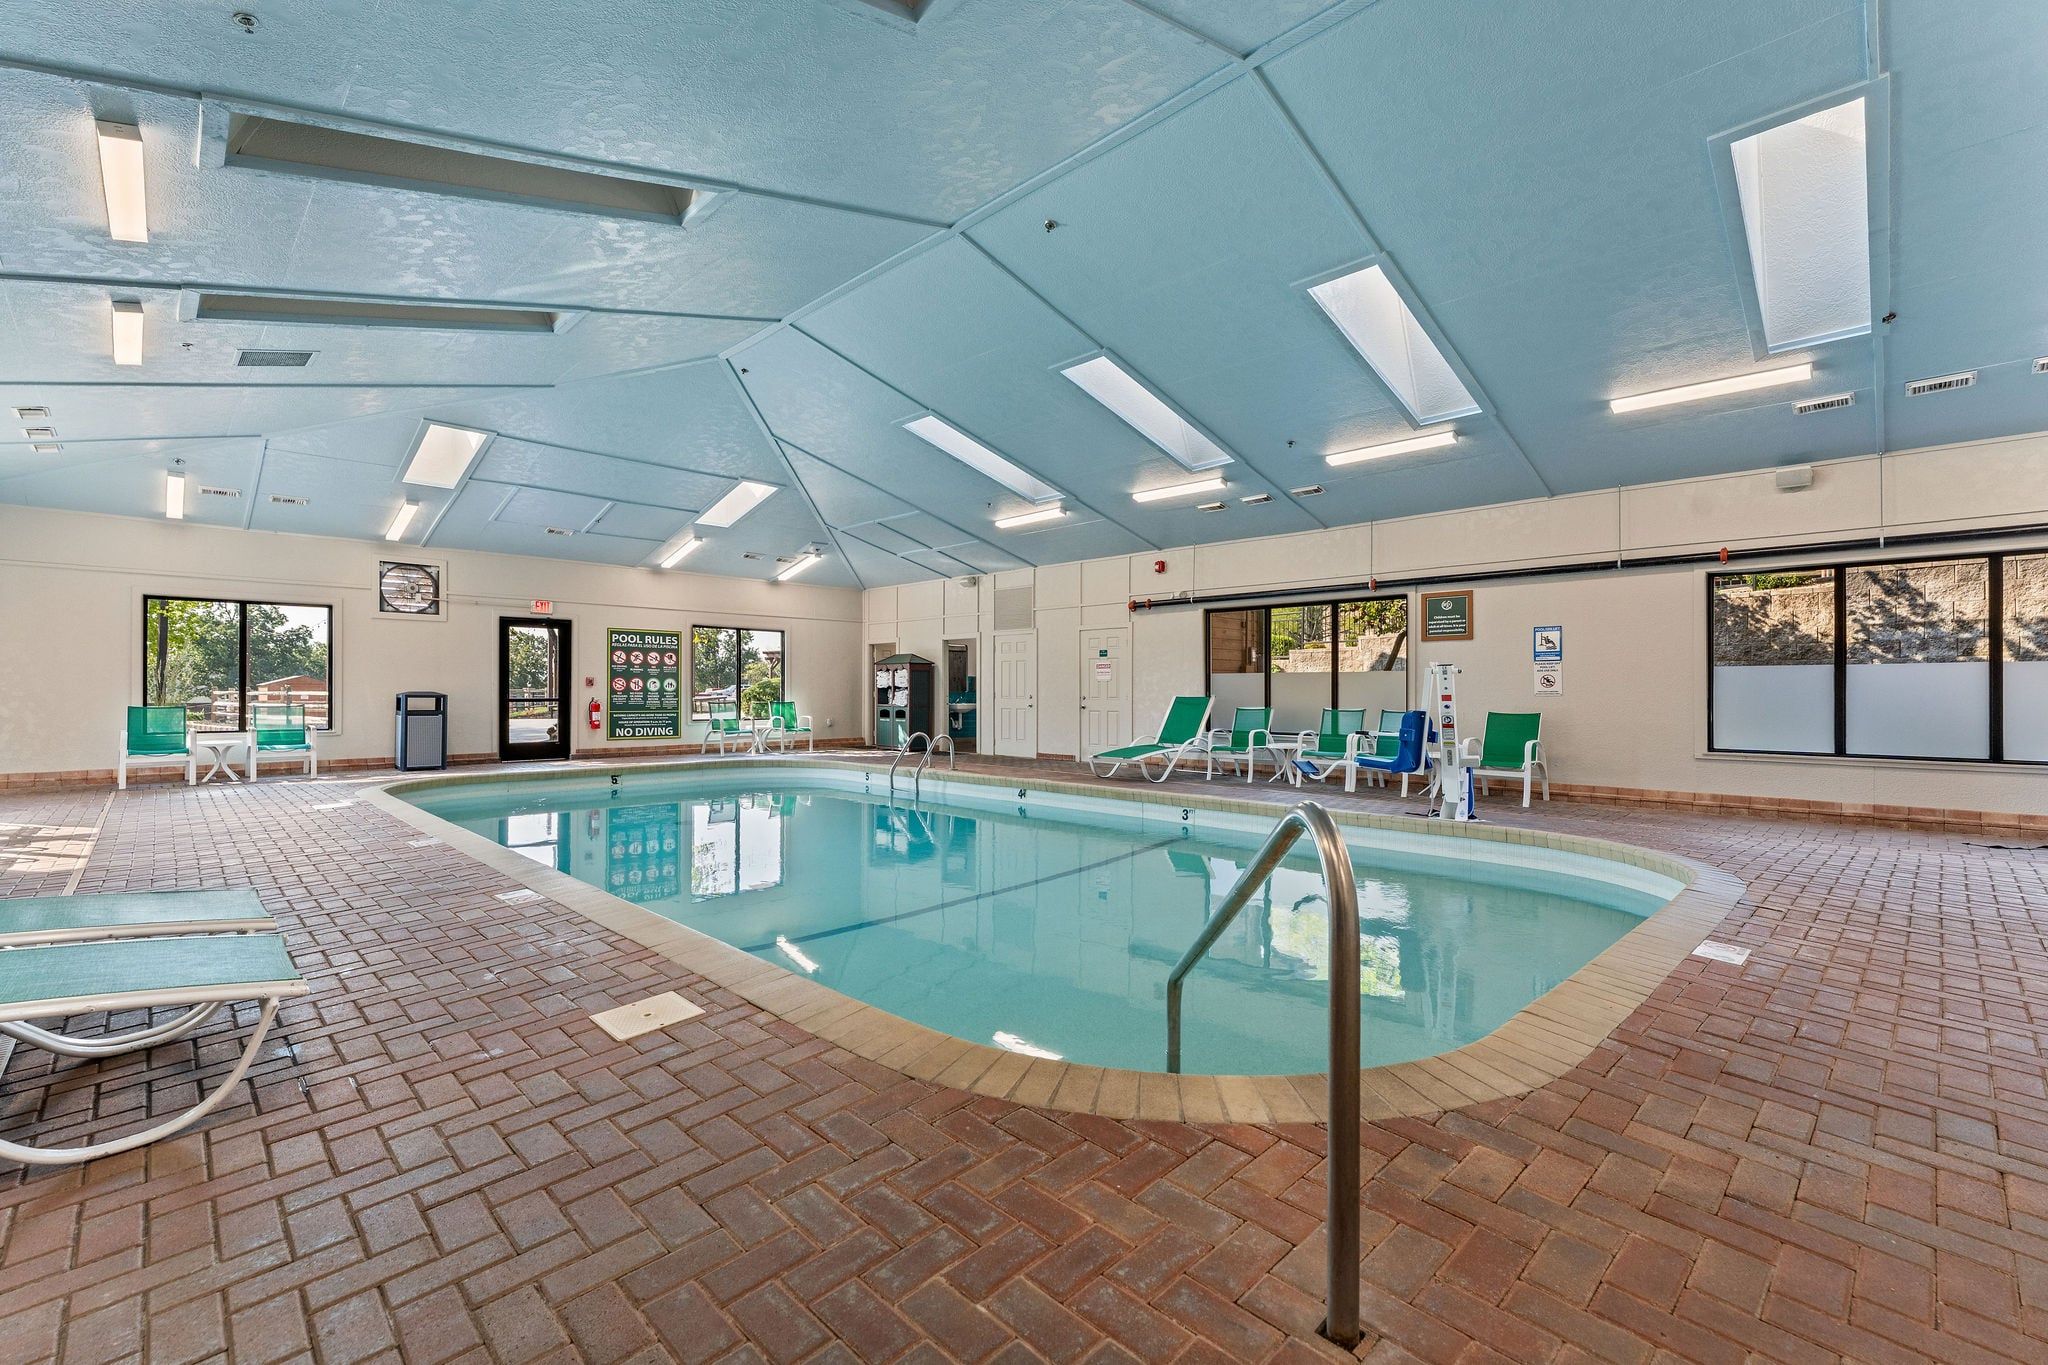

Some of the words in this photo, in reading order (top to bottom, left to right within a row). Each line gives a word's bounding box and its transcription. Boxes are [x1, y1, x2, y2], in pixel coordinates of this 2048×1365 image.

[612, 634, 643, 644] POOL
[645, 635, 678, 645] RULES
[616, 728, 633, 737] NO
[636, 727, 673, 736] DIVING
[1182, 809, 1188, 820] 3
